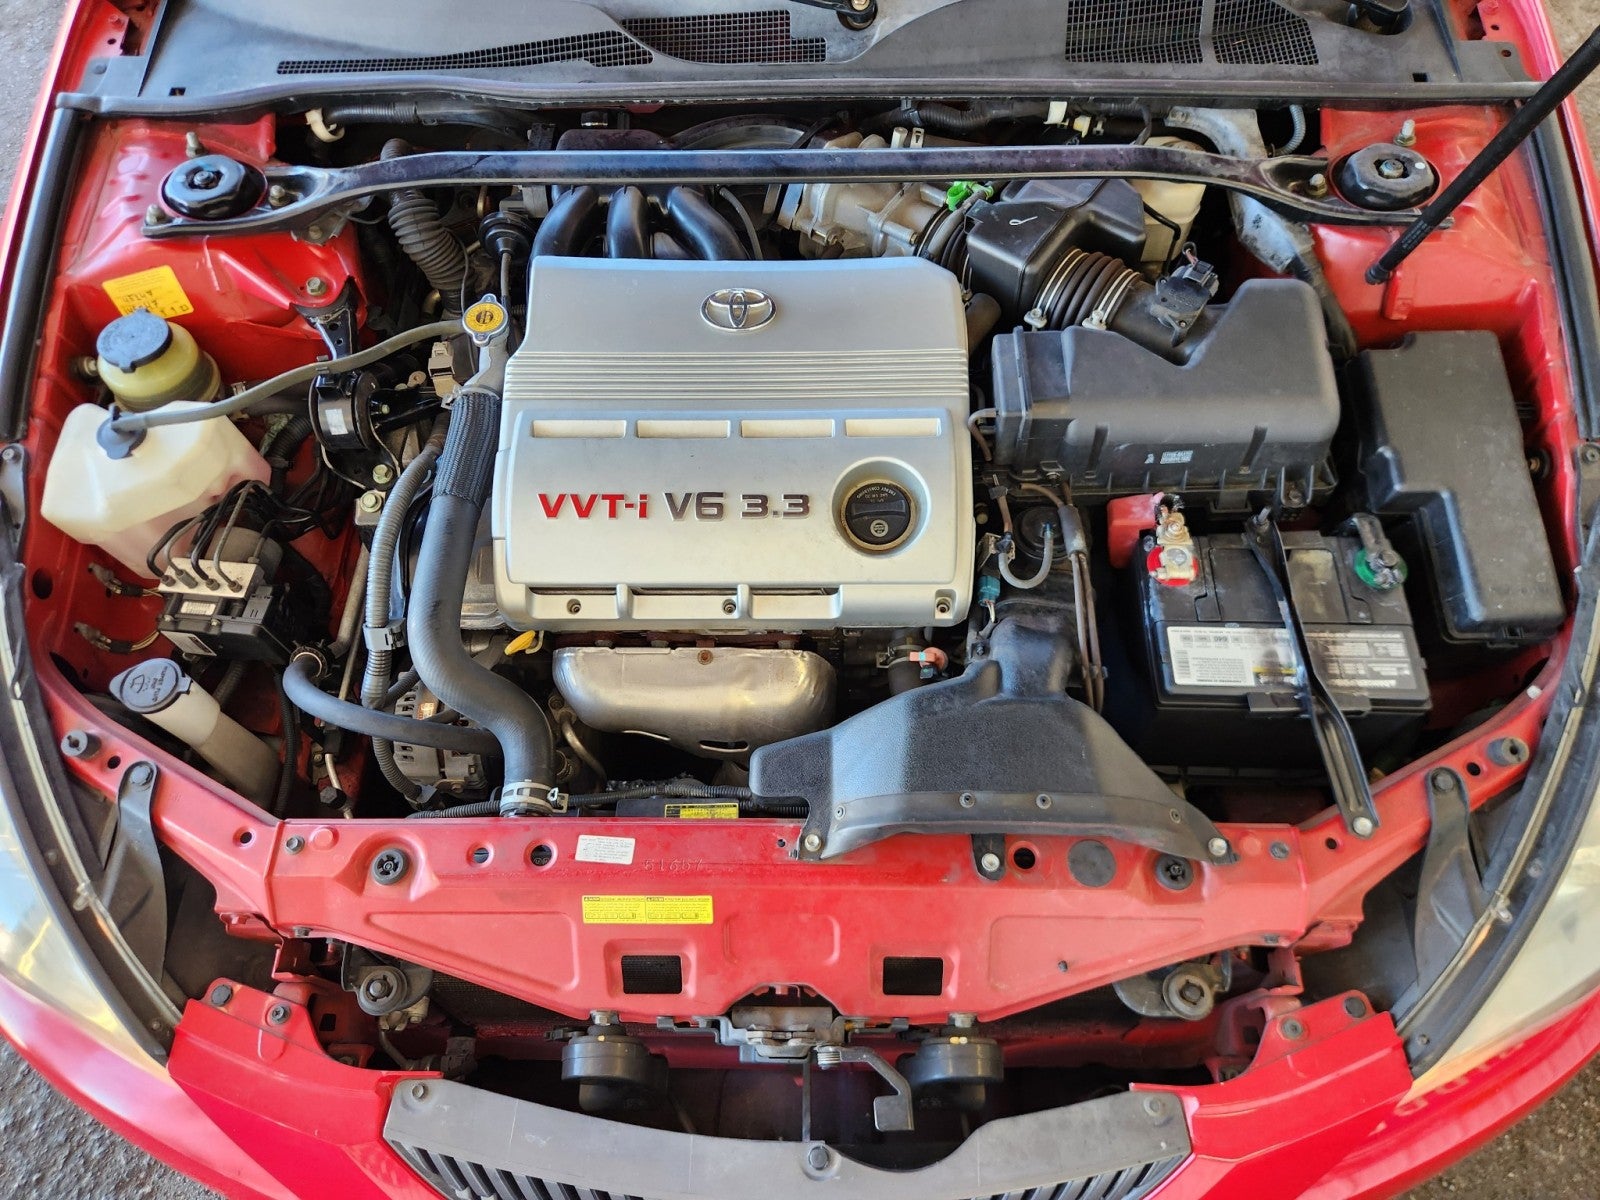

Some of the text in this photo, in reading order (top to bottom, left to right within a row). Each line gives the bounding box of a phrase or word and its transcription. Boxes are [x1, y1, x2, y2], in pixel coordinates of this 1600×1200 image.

[537, 491, 810, 521] VVT-i V6 3.3
